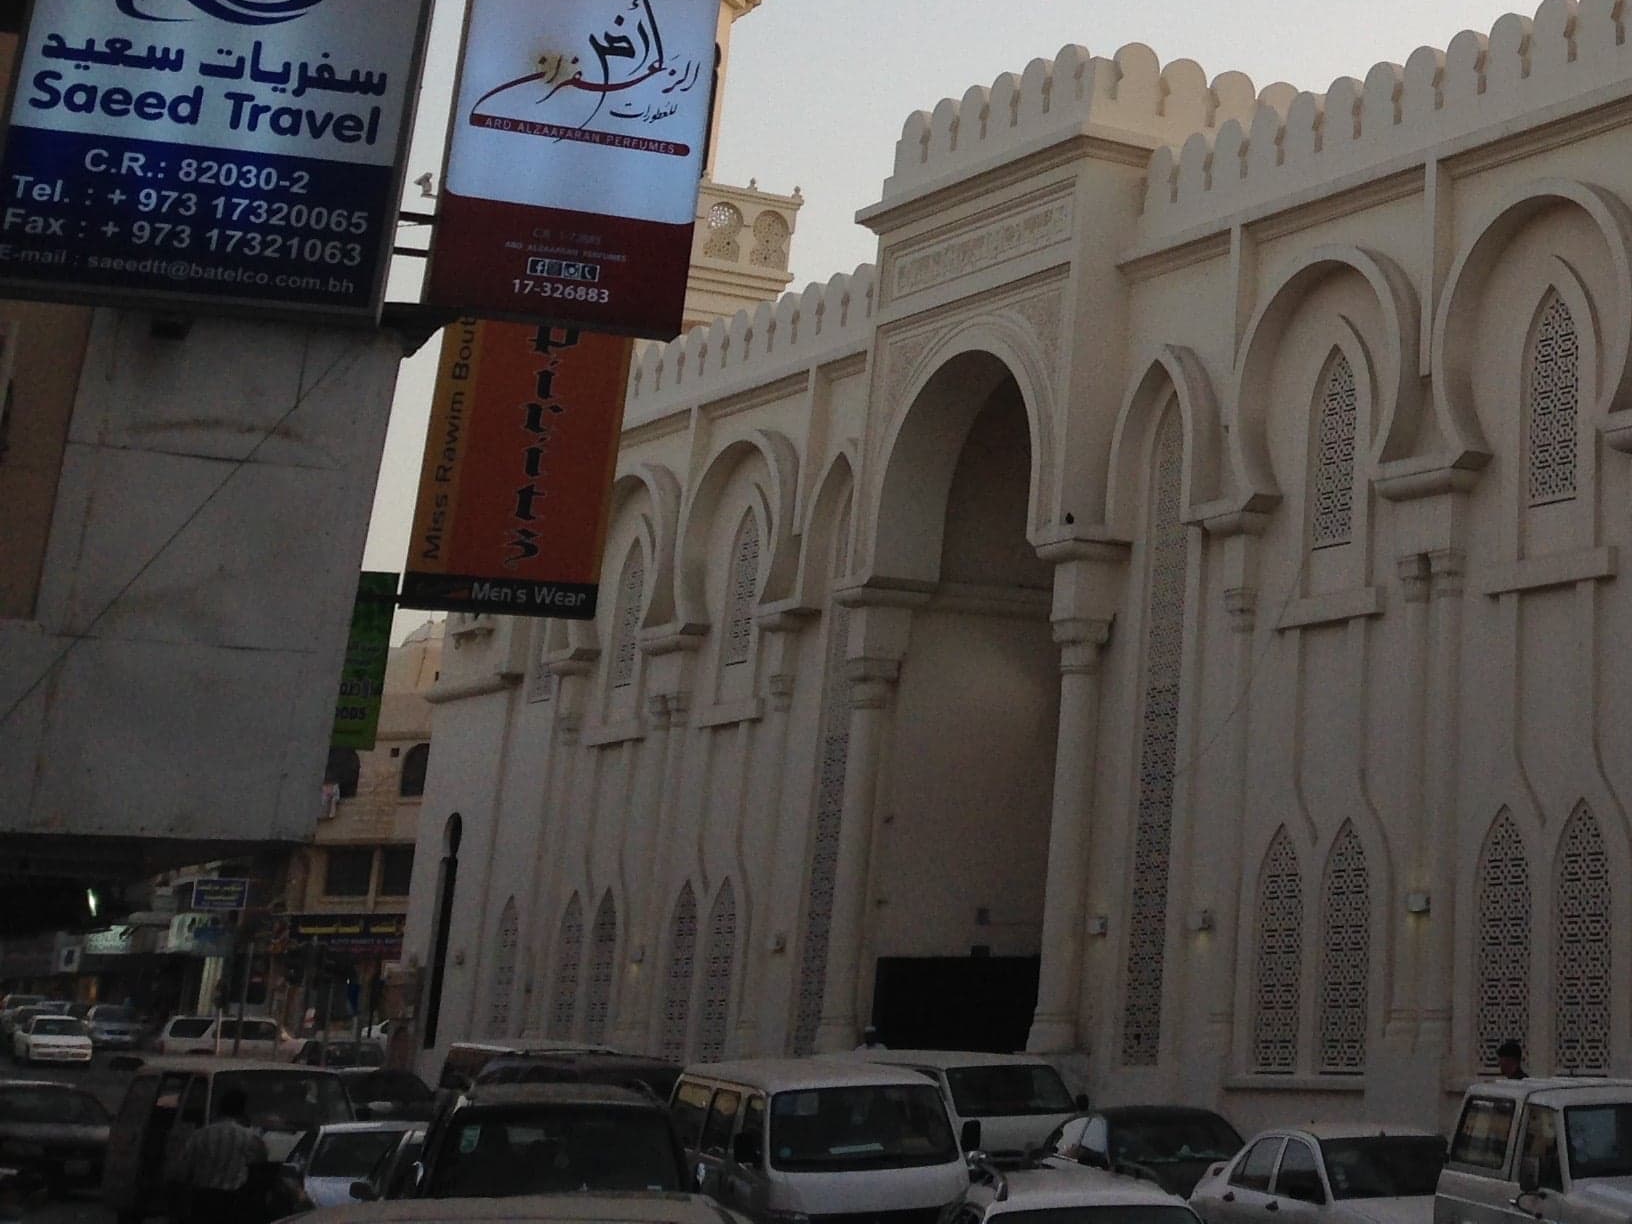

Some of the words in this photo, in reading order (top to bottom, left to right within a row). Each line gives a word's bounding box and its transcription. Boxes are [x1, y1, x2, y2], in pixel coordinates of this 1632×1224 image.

[41, 33, 185, 73] سعيد
[199, 41, 388, 98] سفريات
[28, 70, 205, 126] Saeed
[223, 91, 381, 146] Travel
[485, 117, 511, 130] ARD
[83, 148, 167, 179] C.R.:
[178, 158, 311, 195] 82030-2
[137, 188, 199, 217] 973
[211, 196, 370, 236] 17320065
[3, 207, 66, 237] Fax
[131, 220, 192, 250] 973
[204, 227, 363, 267] 17321063
[511, 278, 610, 305] 17-326883
[423, 492, 449, 561] Miss
[451, 315, 478, 380] Bout
[533, 584, 587, 607] Wear
